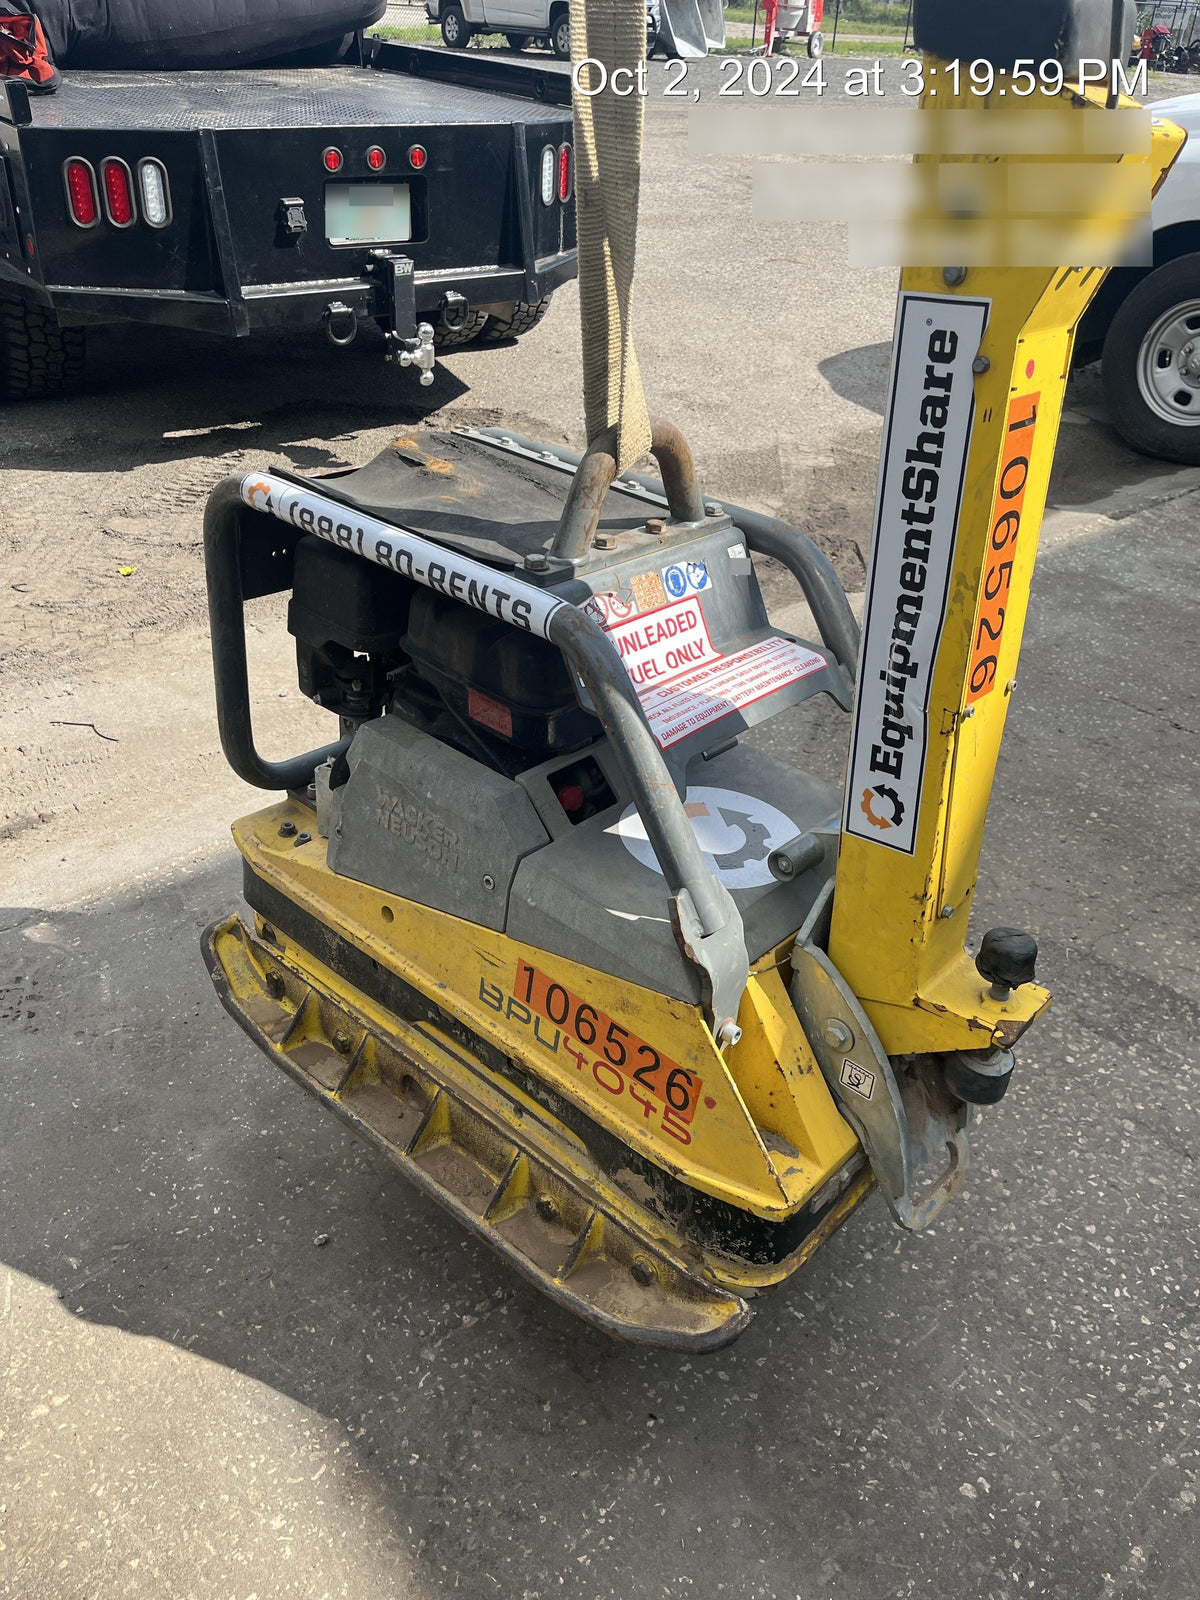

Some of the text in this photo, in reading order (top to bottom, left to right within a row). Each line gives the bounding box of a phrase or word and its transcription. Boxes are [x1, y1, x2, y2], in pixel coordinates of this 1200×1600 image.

[870, 329, 958, 780] EquipmentShare
[970, 405, 1036, 693] 106526
[627, 638, 706, 684] UEL ONLY
[656, 639, 784, 697] CUSTOMER RESPONSIBILITY
[661, 657, 821, 741] DAMAGE TO EQUIPMENT BATTERY MAINTENANCE CLEANING
[523, 965, 694, 1111] 106526
